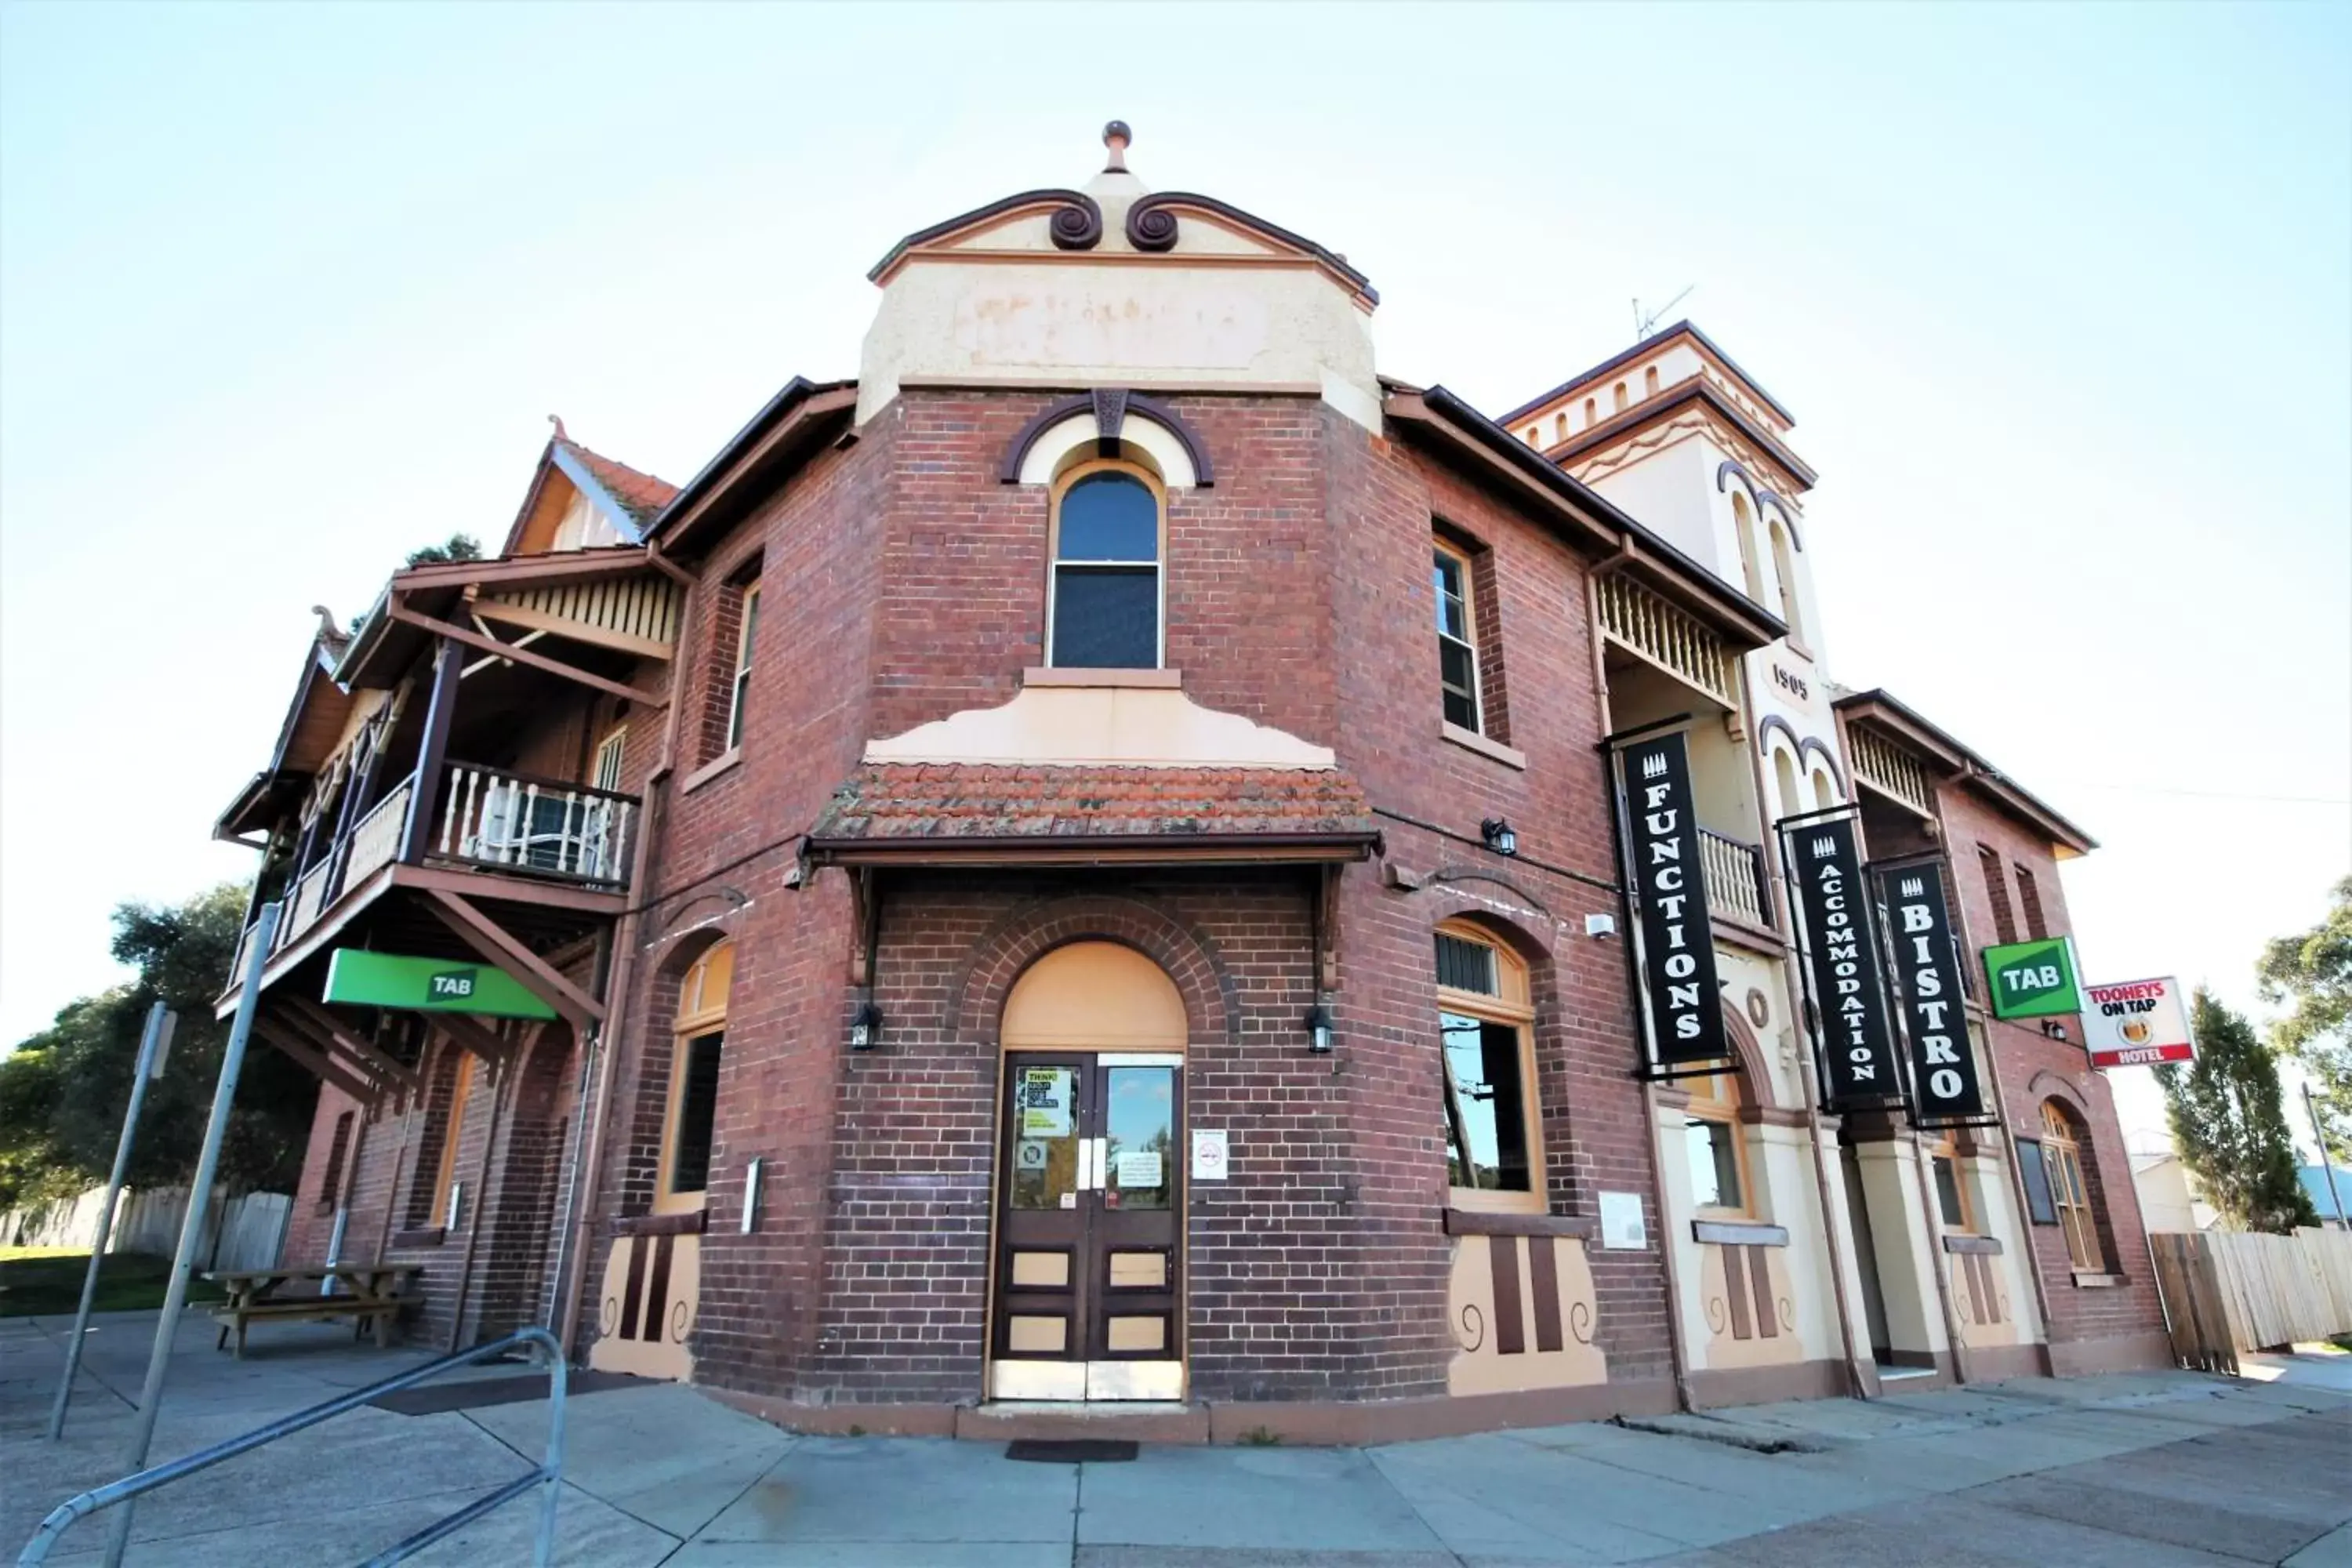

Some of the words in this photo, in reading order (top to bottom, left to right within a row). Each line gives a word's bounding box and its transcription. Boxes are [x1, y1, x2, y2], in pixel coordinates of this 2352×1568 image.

[1773, 663, 1808, 700] 1905
[1645, 784, 1700, 1039] FUNCTIONS
[434, 976, 471, 995] TAB
[1818, 864, 1875, 1081] ACCOMMODATION
[2003, 965, 2060, 991] TAB
[1900, 904, 1963, 1099] BISTRO
[2089, 982, 2165, 1004] TOOHEYS
[2102, 1002, 2125, 1016] ON
[2125, 999, 2157, 1013] TAP
[2118, 1049, 2164, 1064] HOTEL
